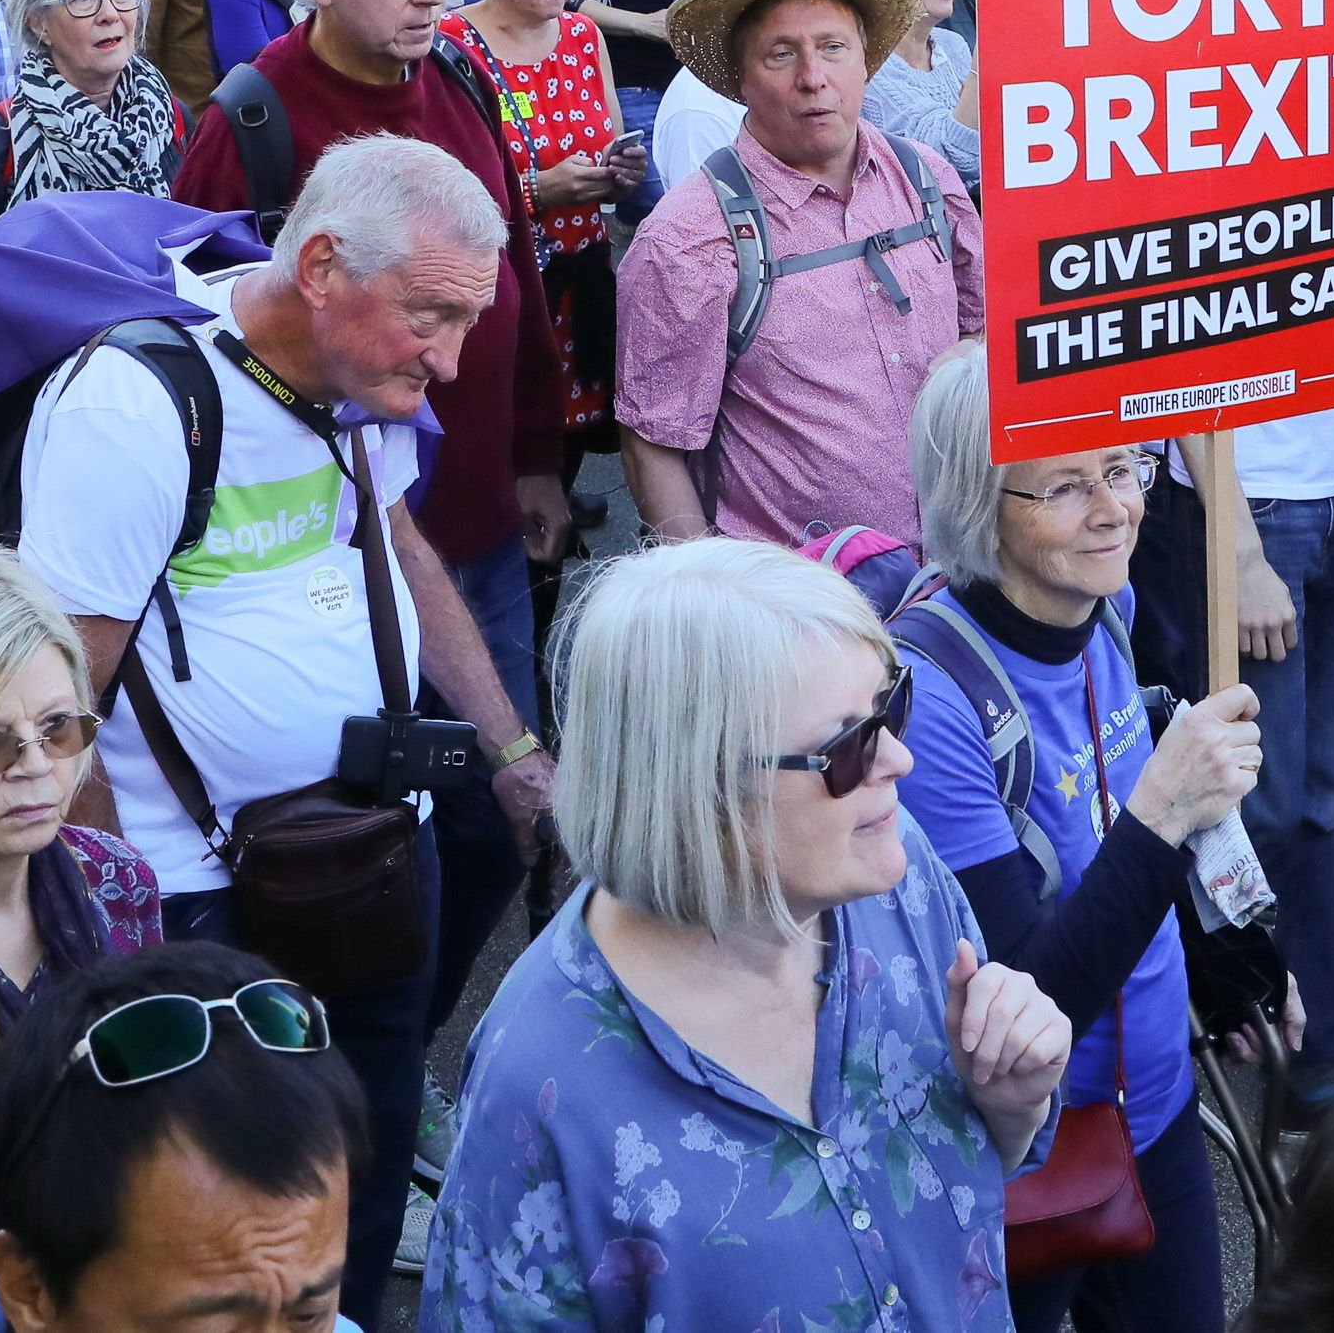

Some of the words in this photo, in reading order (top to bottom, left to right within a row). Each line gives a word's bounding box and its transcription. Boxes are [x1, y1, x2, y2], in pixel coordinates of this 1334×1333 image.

[1049, 228, 1172, 291] GIVE
[1026, 309, 1123, 369] THE
[1140, 281, 1278, 349] FINAL
[242, 356, 296, 405] CONTOOSE
[1124, 394, 1179, 417] ANOTHER
[1182, 386, 1226, 409] EUROPE
[1228, 384, 1239, 401] IS
[1242, 374, 1291, 398] POSSIBLE
[205, 500, 328, 558] eople's
[992, 708, 1013, 733] deuter
[1110, 693, 1141, 728] Brexit
